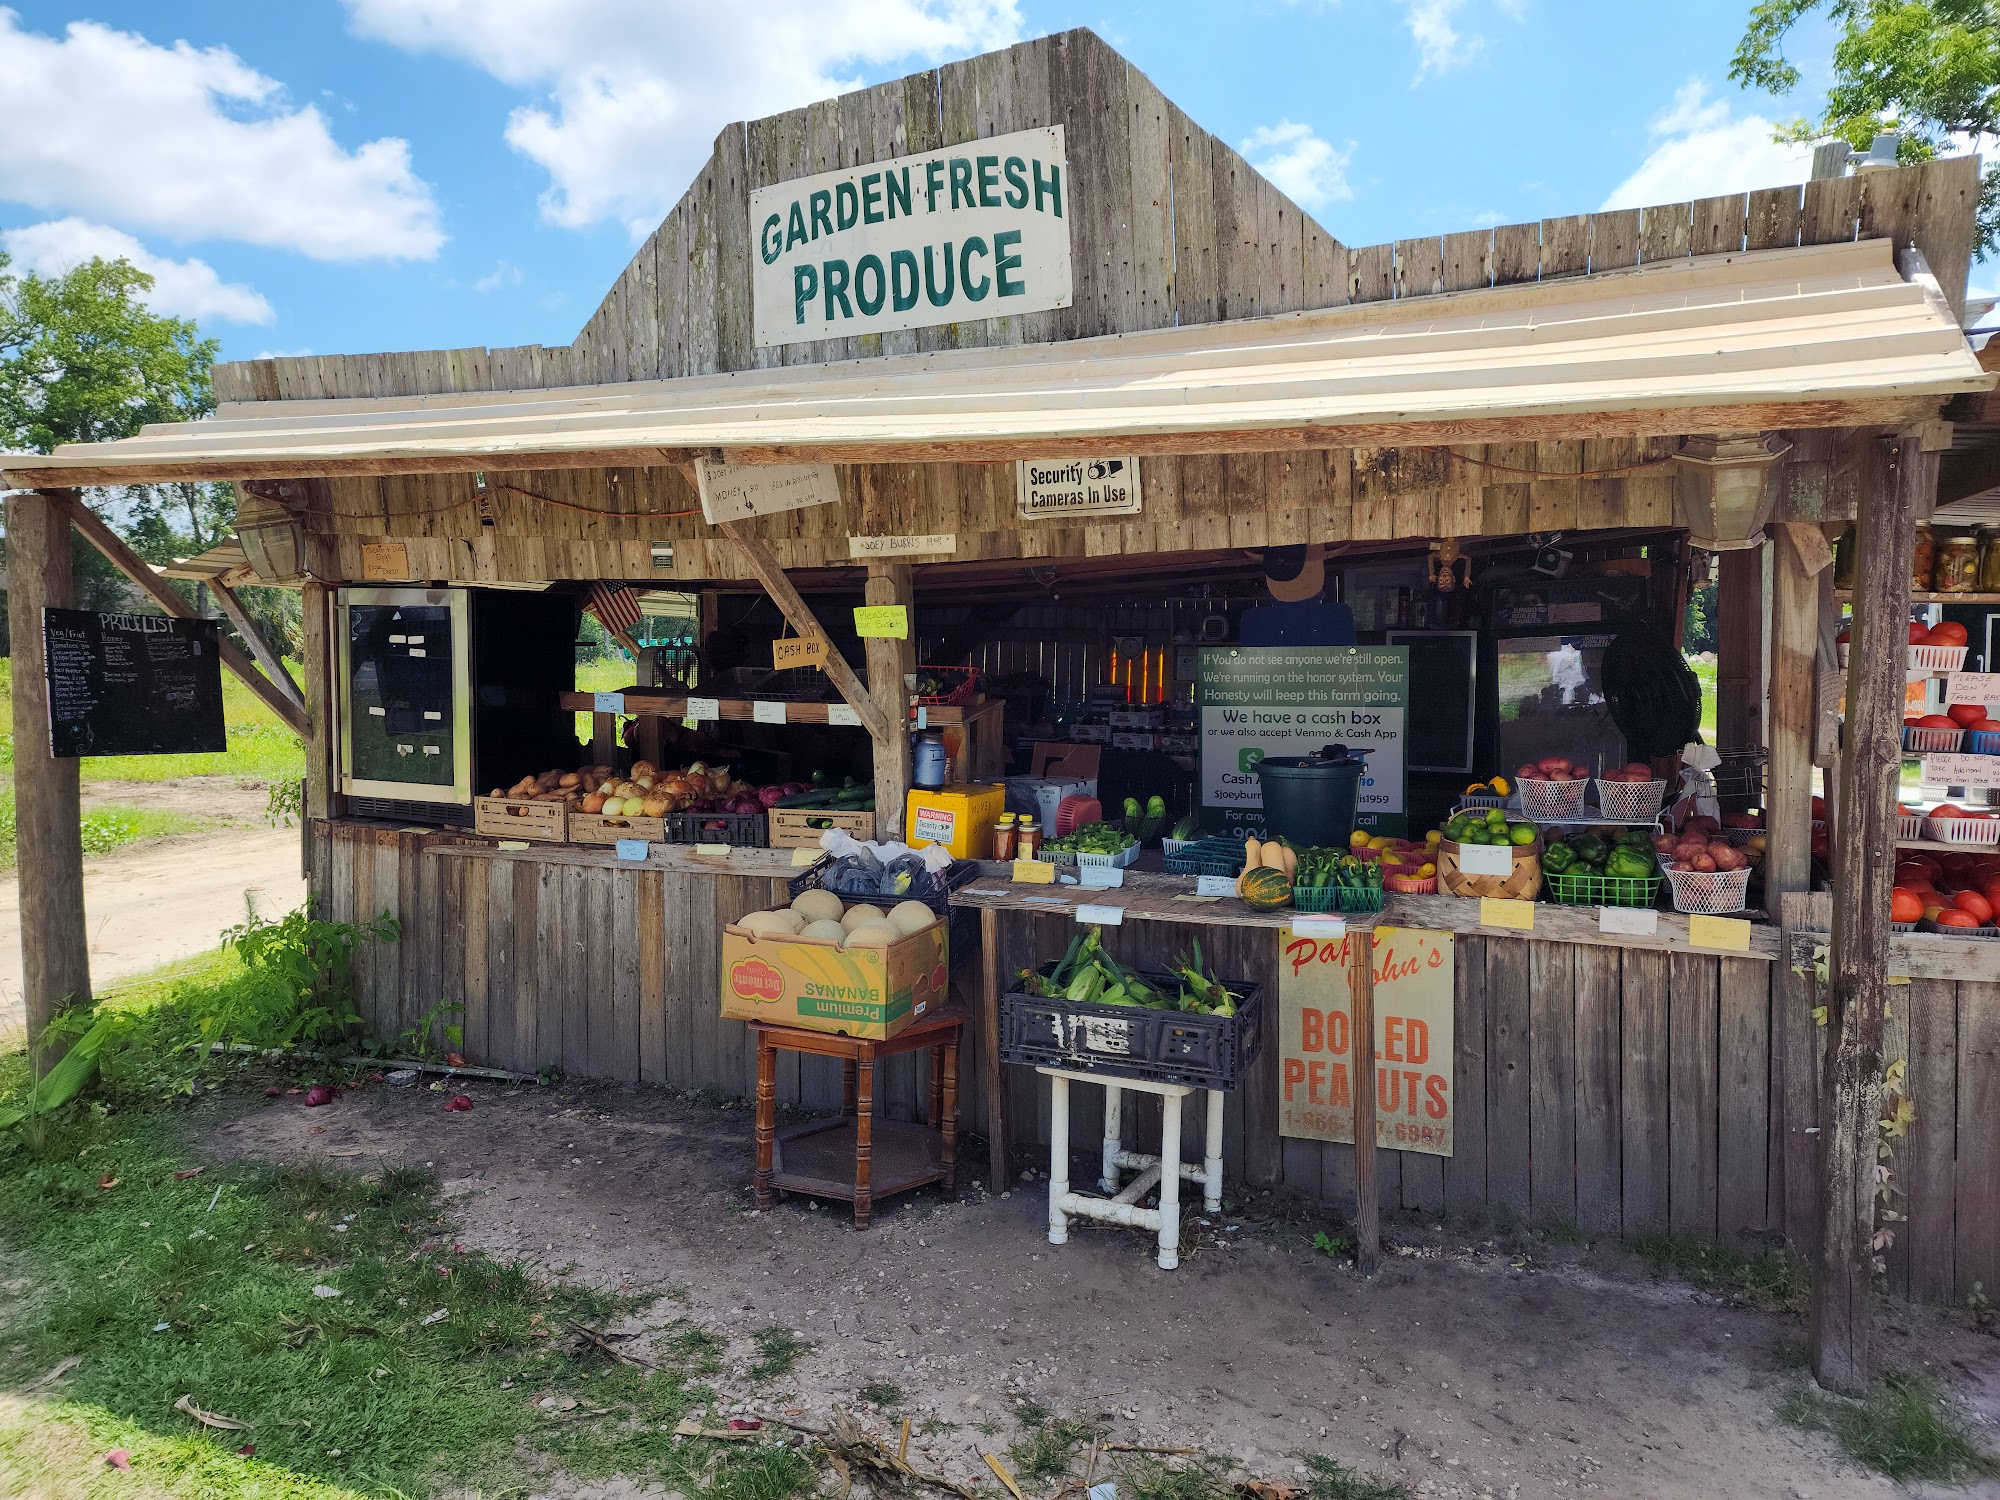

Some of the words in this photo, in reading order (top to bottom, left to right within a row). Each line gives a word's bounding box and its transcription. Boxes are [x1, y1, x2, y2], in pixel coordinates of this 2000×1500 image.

[761, 165, 912, 265] GARDEN
[925, 155, 1063, 218] FRESH
[794, 229, 1026, 325] PRODUCE
[1031, 465, 1083, 486] Security
[1032, 490, 1083, 507] Cameras
[1088, 486, 1100, 503] In
[1104, 485, 1126, 502] Use
[864, 540, 885, 551] JOEY
[890, 538, 920, 549] BURRIS
[858, 609, 890, 621] Please
[778, 645, 801, 660] CASH
[806, 642, 820, 655] BOX
[1203, 654, 1210, 665] If
[1212, 653, 1231, 665] You
[1234, 654, 1246, 664] do
[1249, 655, 1265, 665] not
[1267, 656, 1282, 664] see
[1285, 656, 1322, 666] anyone
[1325, 653, 1352, 664] we're
[1355, 653, 1371, 664] still
[1374, 655, 1403, 666] open.
[1203, 672, 1231, 682] We're
[1233, 672, 1270, 684] running
[1273, 674, 1285, 682] on
[1288, 671, 1304, 682] the
[1306, 671, 1336, 682] honor
[1338, 672, 1375, 684] system.
[1378, 671, 1403, 682] Your
[1953, 674, 1992, 682] PLEASE
[1204, 689, 1250, 702] Honesty
[1253, 689, 1272, 700] will
[1276, 689, 1304, 702] keep
[1308, 689, 1328, 700] this
[1331, 689, 1360, 700] farm
[1364, 690, 1401, 702] going.
[1223, 710, 1248, 723] We
[1253, 710, 1291, 723] have
[1296, 714, 1306, 723] a
[1312, 711, 1345, 724] cash
[1351, 711, 1381, 724] box
[1237, 728, 1256, 736] also
[1259, 728, 1292, 738] accept
[1295, 728, 1331, 737] Venmo
[1334, 729, 1343, 738] &
[1346, 729, 1370, 738] Cash
[1374, 729, 1397, 739] App
[1221, 773, 1252, 785] Cash
[1214, 789, 1261, 801] $joeyburr
[1357, 794, 1389, 804] is1959
[919, 809, 952, 821] WARNING
[1225, 810, 1243, 821] For
[1246, 811, 1265, 823] any
[1358, 815, 1377, 826] call
[919, 820, 937, 830] Security
[1347, 938, 1444, 988] ohn's
[733, 973, 764, 989] Monte
[765, 978, 780, 991] Del
[805, 982, 879, 1001] BANANAS
[816, 1001, 880, 1020] Premium
[1302, 1007, 1429, 1065] BOED
[1284, 1057, 1448, 1120] PEAUTS
